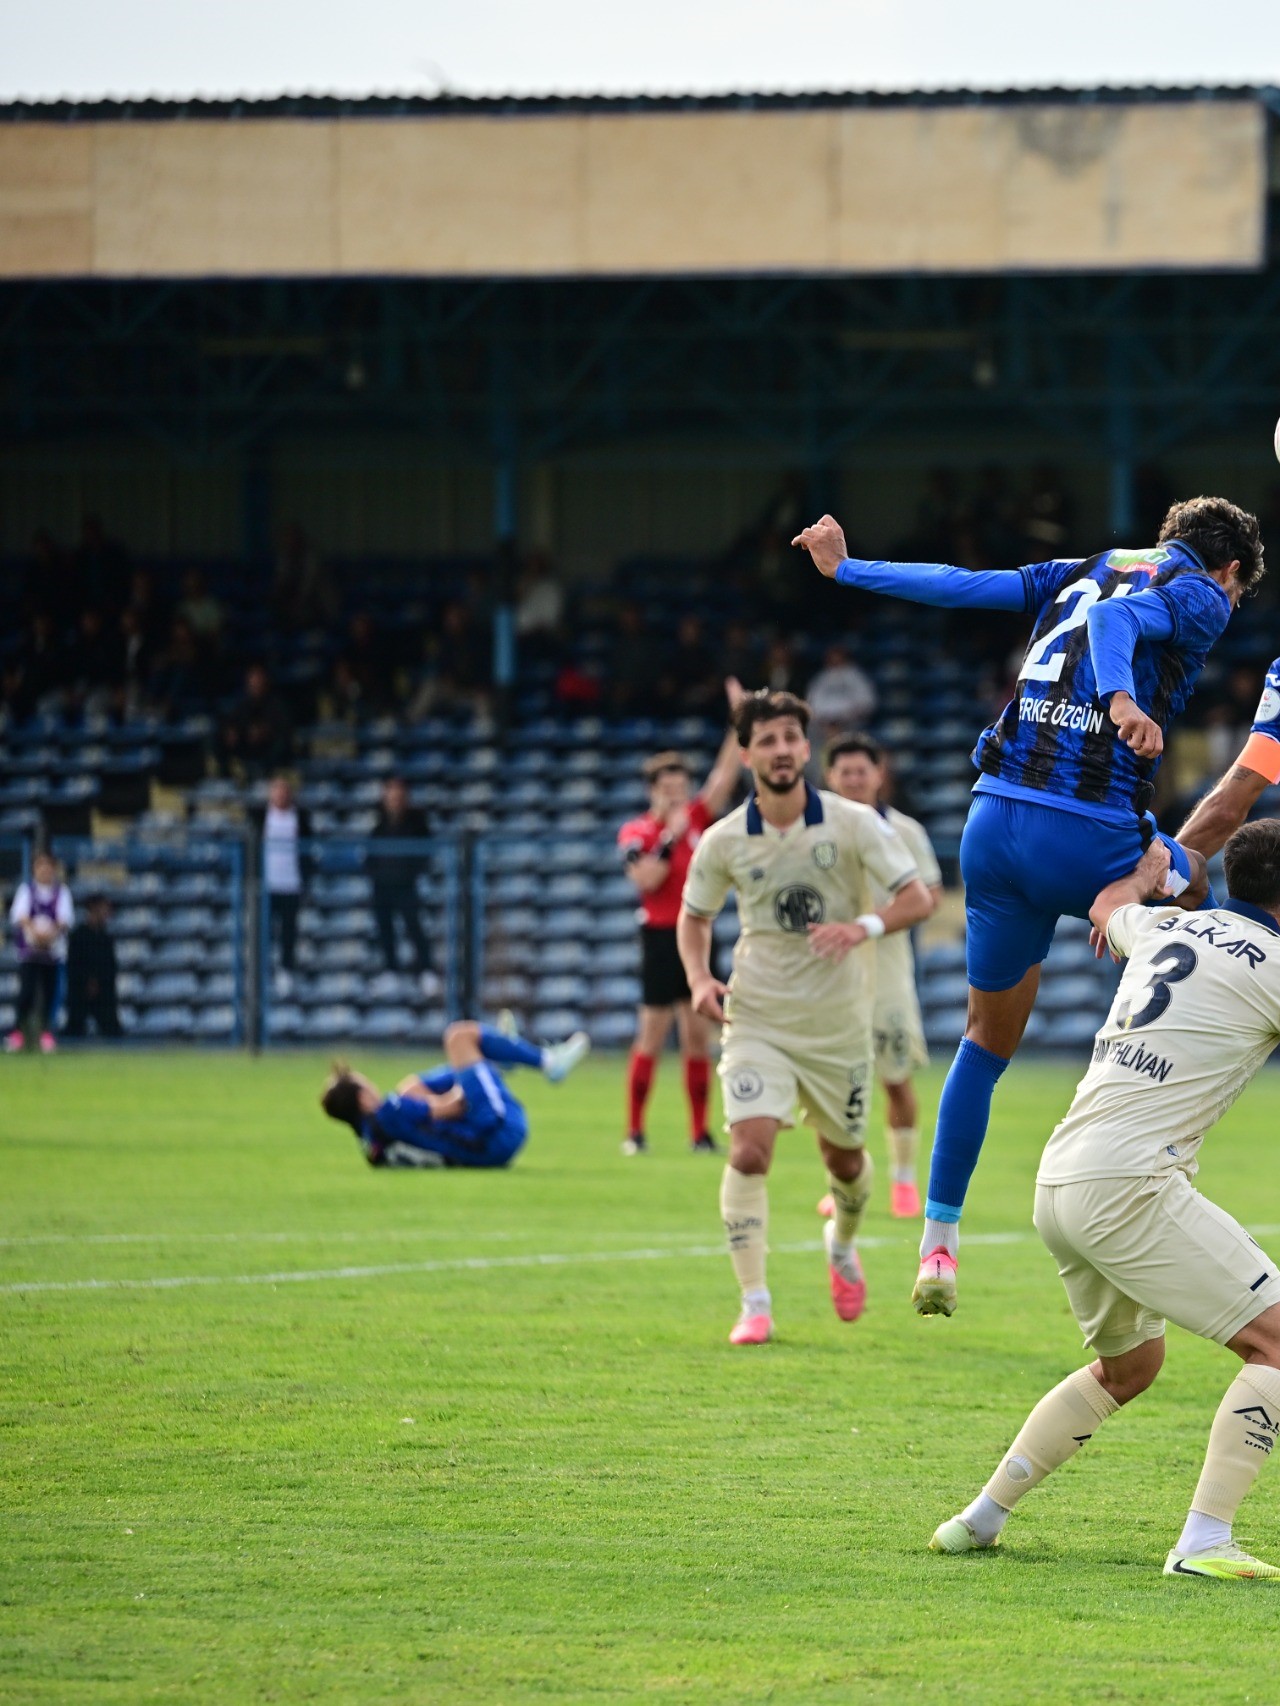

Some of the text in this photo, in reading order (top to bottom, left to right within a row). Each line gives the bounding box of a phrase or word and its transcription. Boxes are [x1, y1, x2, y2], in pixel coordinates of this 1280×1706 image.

[1050, 697, 1104, 735] ÖZGÜN
[1116, 940, 1199, 1031] 3
[845, 1085, 864, 1119] 5
